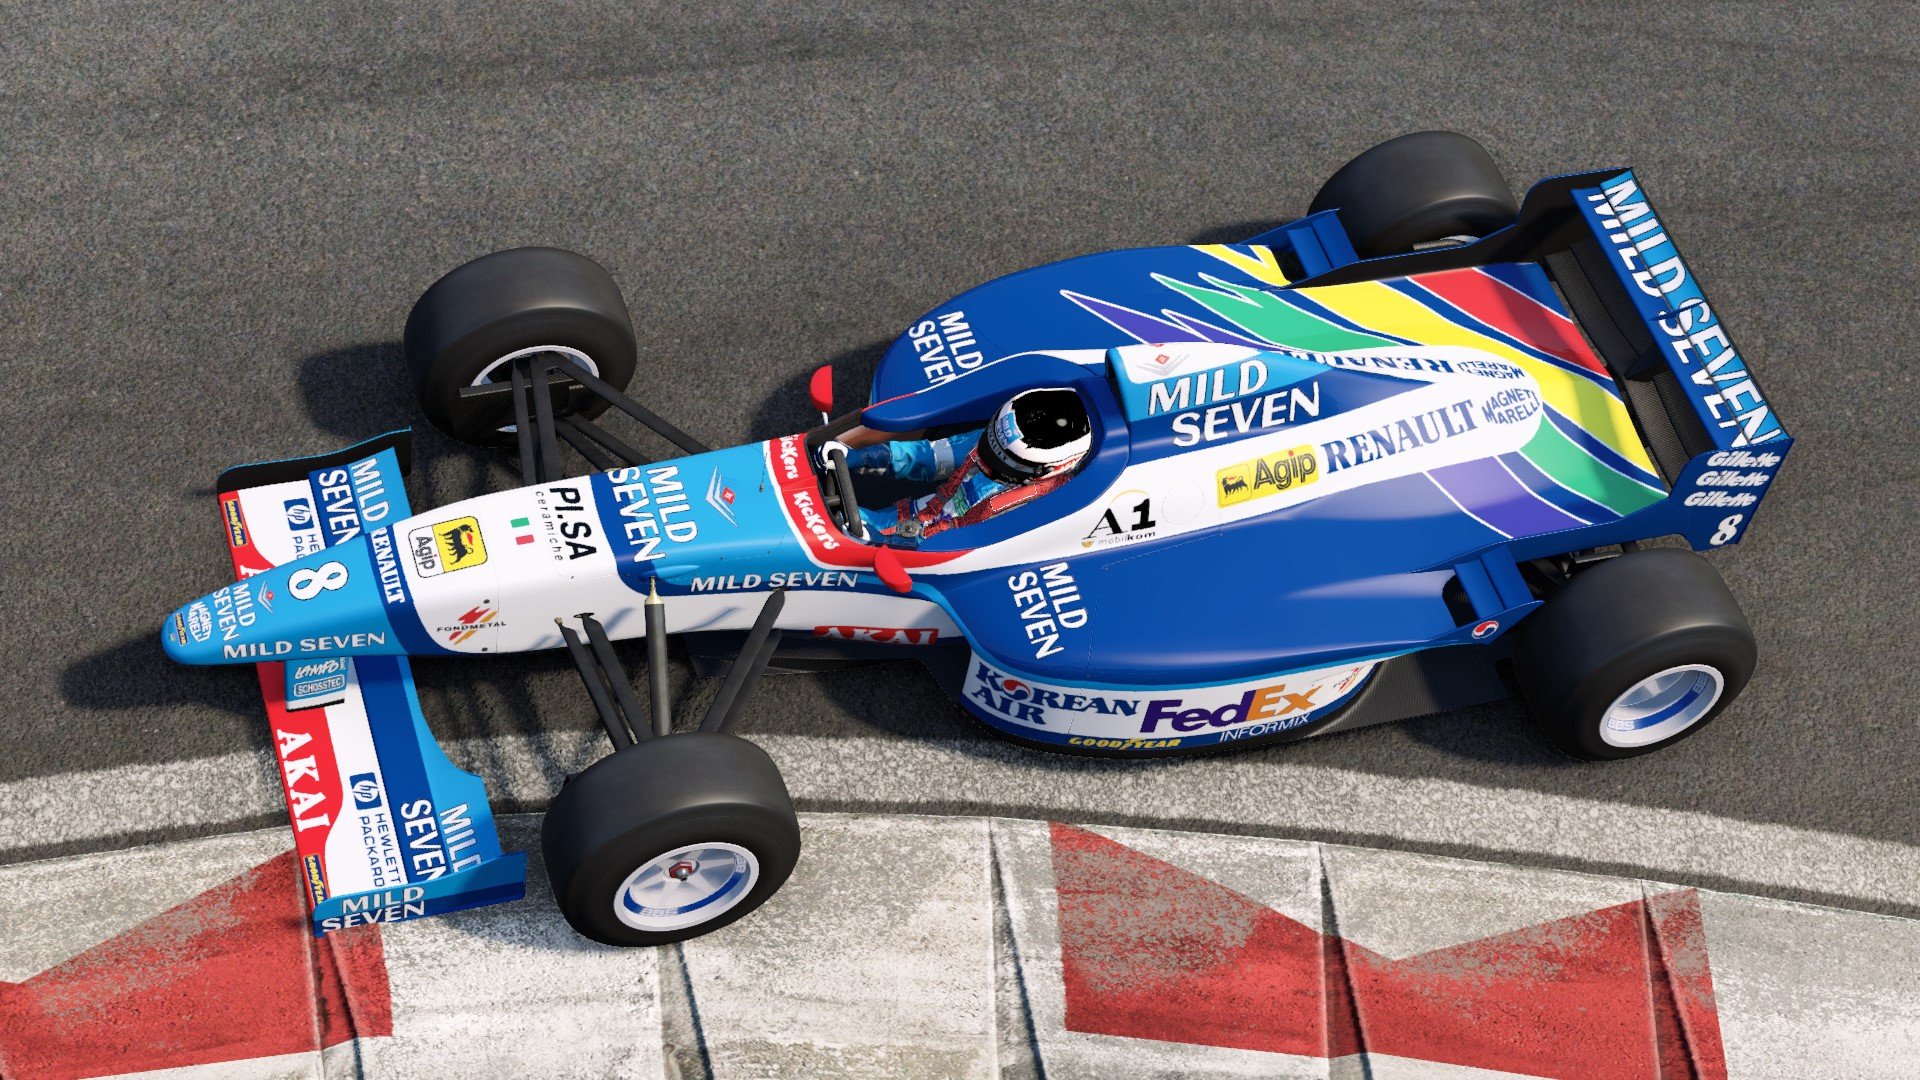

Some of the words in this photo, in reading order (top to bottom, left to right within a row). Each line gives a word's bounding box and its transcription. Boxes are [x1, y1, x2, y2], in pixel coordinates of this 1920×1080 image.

[1587, 179, 1687, 298] MILD
[1657, 298, 1782, 448] SEVEN
[937, 310, 984, 369] MILD
[1148, 360, 1268, 415] MILD
[1482, 388, 1540, 418] MAGNETI
[1172, 381, 1320, 447] SEVEN
[1482, 398, 1540, 424] MARELLI
[1321, 399, 1478, 474] RENAULT
[1254, 451, 1317, 490] Agip
[1696, 470, 1769, 487] Gillette
[1707, 451, 1781, 467] Gillette
[351, 458, 390, 522] MILD
[647, 465, 697, 543] MILD
[1684, 491, 1757, 507] Gillette
[535, 491, 563, 561] ceramiche
[549, 487, 597, 560] PI.SA
[607, 467, 667, 563] SEVEN
[1082, 498, 1156, 540] A1
[1709, 513, 1743, 546] 8
[416, 536, 438, 570] Agip
[1098, 531, 1156, 545] mobilkom
[288, 561, 349, 601] 8
[370, 526, 406, 605] RENAULT
[690, 574, 762, 592] MILD
[768, 572, 859, 588] SEVEN
[213, 587, 240, 641] SEVEN
[233, 583, 256, 627] MILD
[1008, 570, 1064, 660] SEVEN
[1040, 562, 1088, 629] MILD
[223, 641, 293, 659] MILD
[300, 632, 385, 652] SEVEN
[436, 621, 507, 632] FONDMETAL
[819, 627, 934, 645] AKAI
[972, 686, 1047, 725] AIR
[976, 662, 1140, 717] KOREAN
[1140, 684, 1323, 733] FedEx
[1068, 737, 1182, 750] GOODYEAR
[1220, 713, 1310, 742] INFORMIX
[277, 728, 330, 832] AKAI
[353, 780, 380, 801] hp
[359, 816, 386, 887] PACKARD
[375, 813, 401, 884] HEWLETT
[307, 856, 325, 904] GOODYEA
[342, 886, 425, 914] MILD
[322, 901, 425, 933] SEVEN
